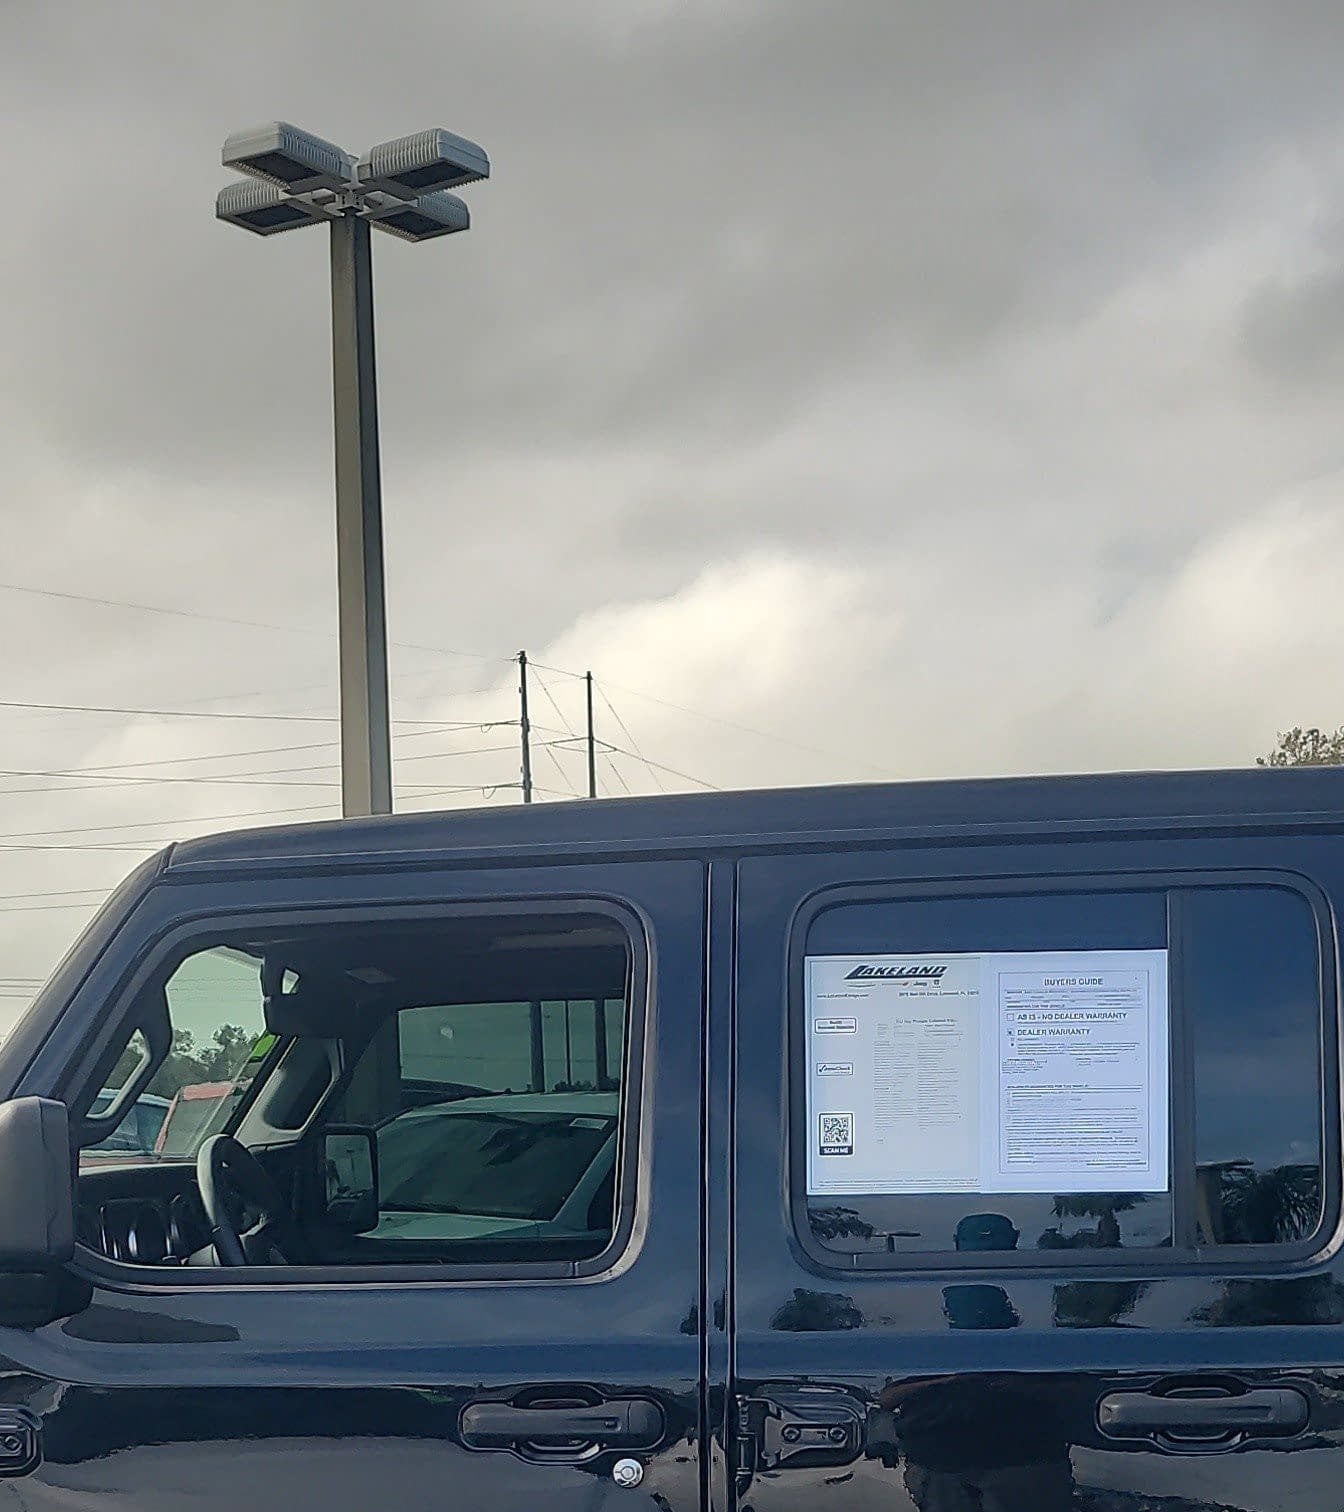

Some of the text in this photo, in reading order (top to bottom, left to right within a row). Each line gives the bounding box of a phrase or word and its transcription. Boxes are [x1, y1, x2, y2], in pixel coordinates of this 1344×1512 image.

[844, 965, 948, 980] LAKELAND
[1044, 978, 1103, 986] BUYERS GUIDE
